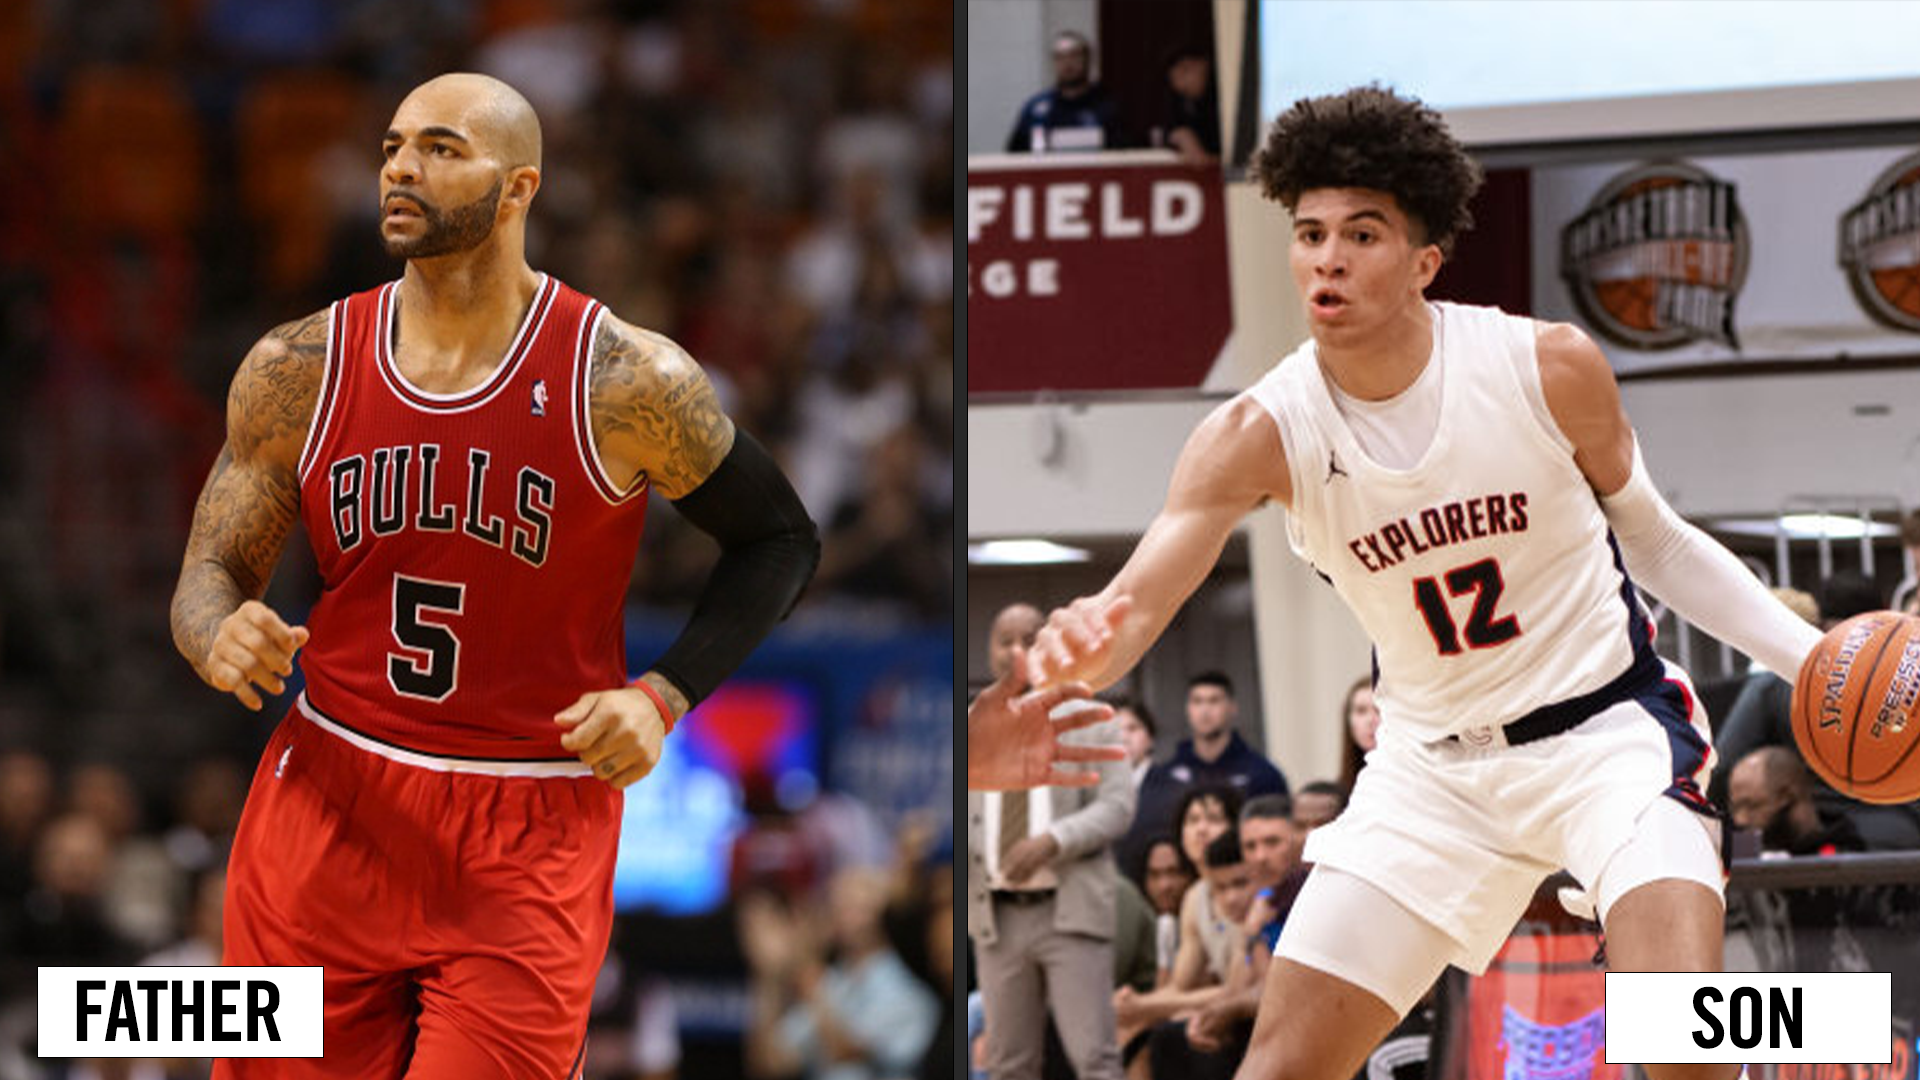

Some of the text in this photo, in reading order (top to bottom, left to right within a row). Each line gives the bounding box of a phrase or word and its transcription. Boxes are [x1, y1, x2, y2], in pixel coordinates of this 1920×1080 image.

[968, 181, 1204, 242] FIELD
[968, 260, 1060, 298] GE
[330, 444, 554, 568] BULLS
[1348, 493, 1528, 573] EXPLORERS
[387, 572, 466, 703] 5
[1413, 557, 1522, 656] 12
